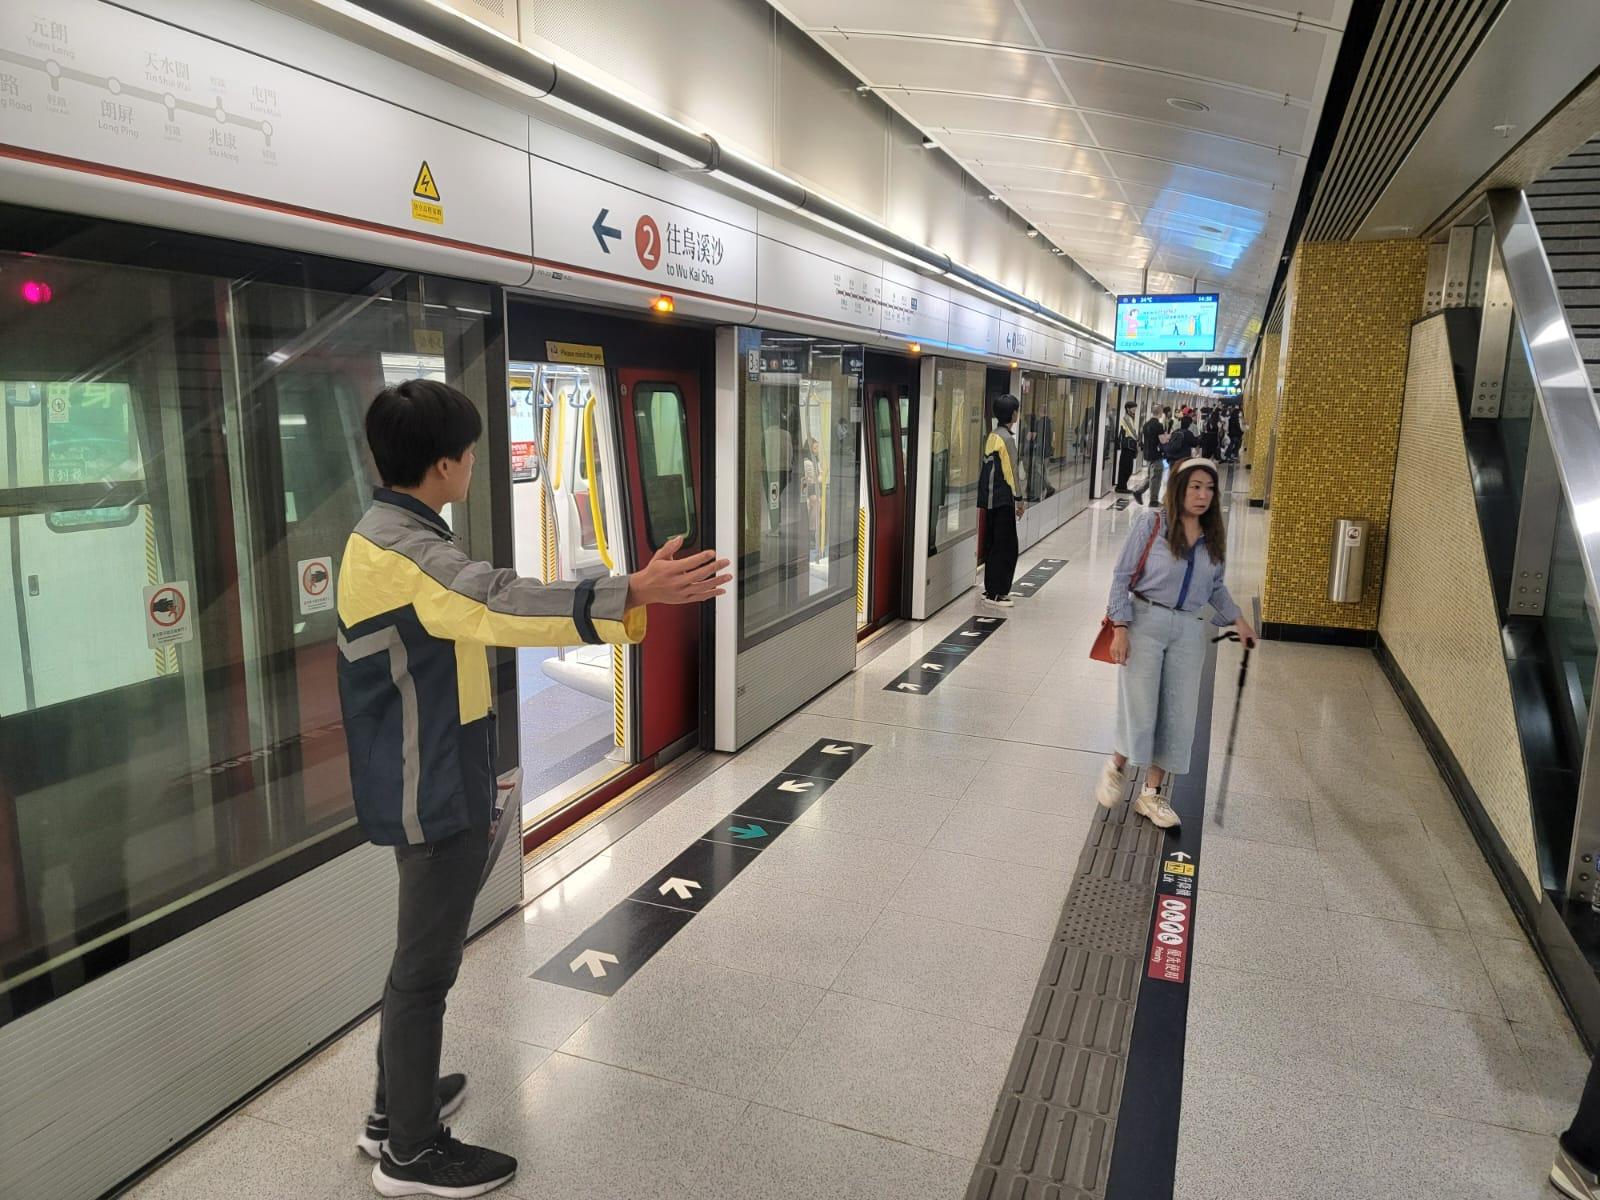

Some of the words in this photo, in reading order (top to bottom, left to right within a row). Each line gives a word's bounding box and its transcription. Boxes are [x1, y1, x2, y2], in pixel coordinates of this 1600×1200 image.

[98, 119, 119, 134] Long
[642, 224, 655, 261] 2
[666, 221, 724, 266] 往烏溪沙
[666, 262, 675, 276] to
[675, 263, 688, 280] Wu
[689, 266, 700, 282] Kai
[701, 269, 714, 285] Sha
[1163, 873, 1175, 883] Lift
[1175, 876, 1192, 896] 升降機
[1152, 946, 1164, 963] Priority
[1164, 948, 1182, 980] 優先使用
